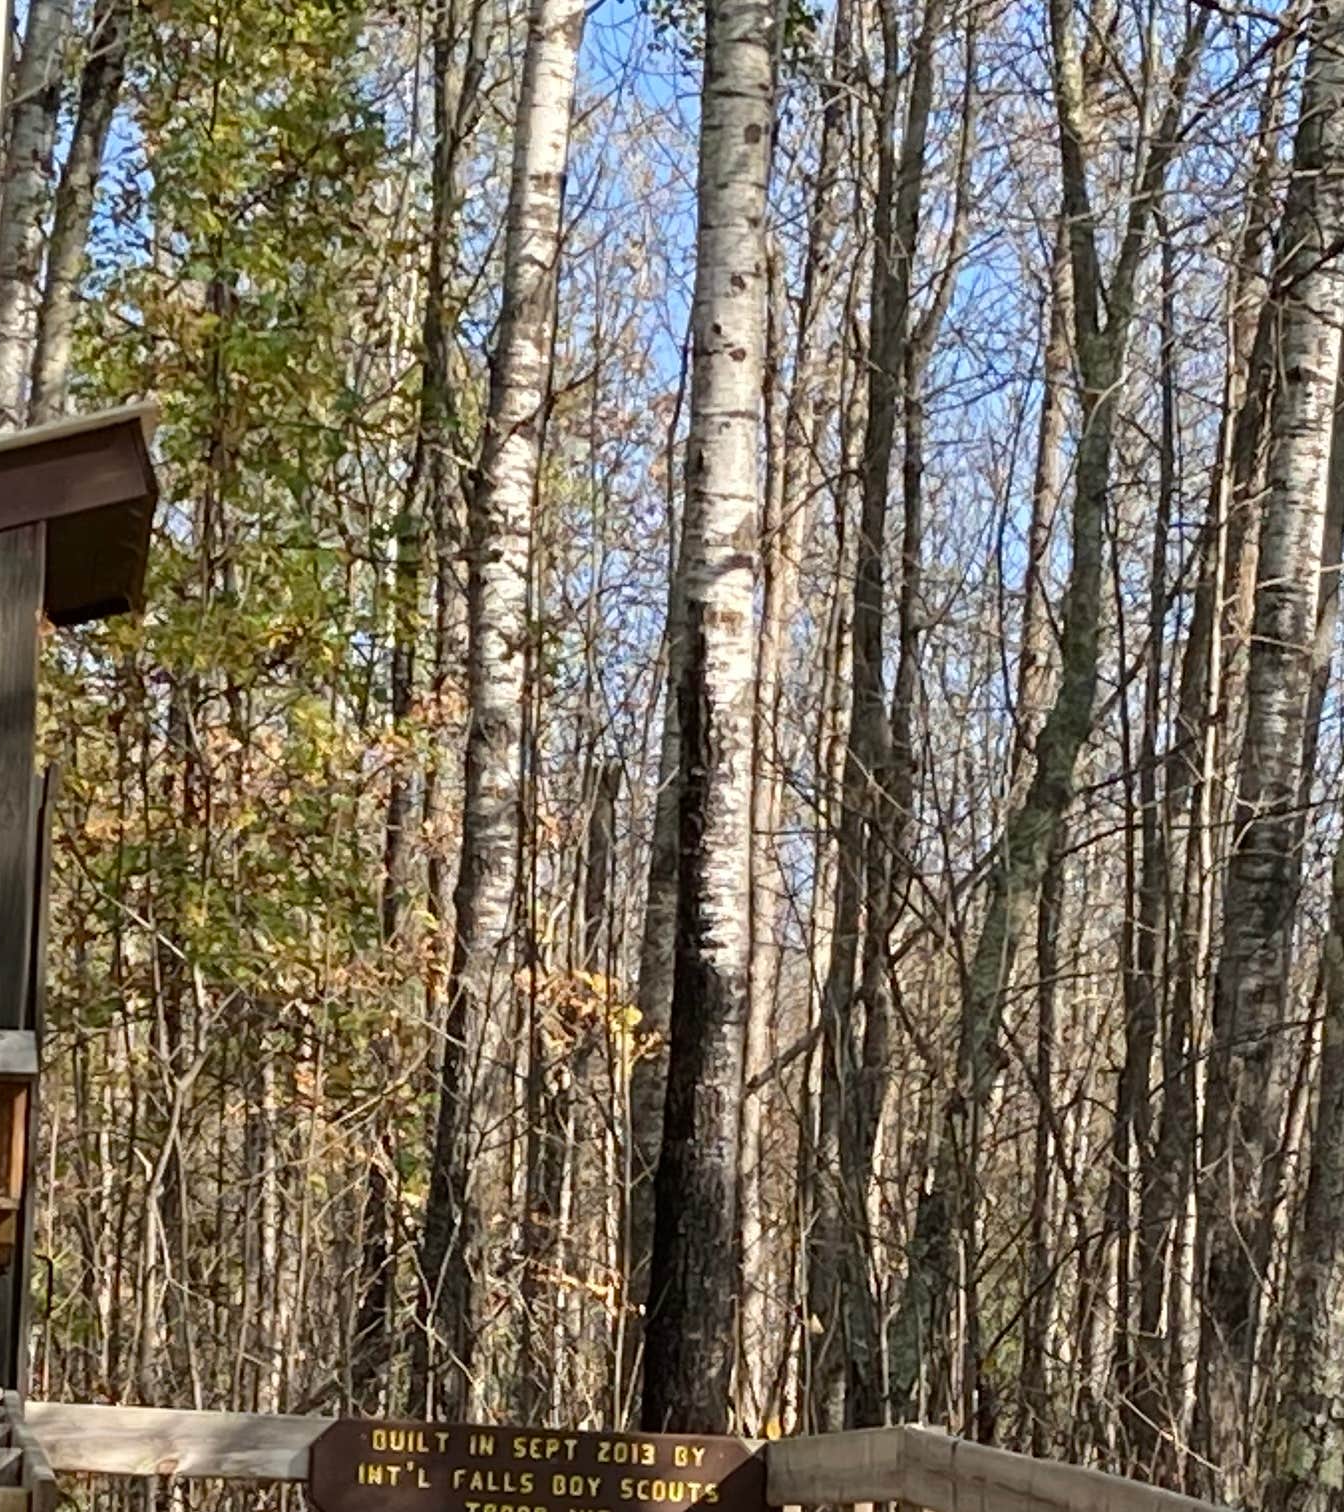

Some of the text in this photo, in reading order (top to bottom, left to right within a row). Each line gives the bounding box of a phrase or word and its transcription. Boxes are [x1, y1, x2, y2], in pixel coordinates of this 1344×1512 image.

[372, 1429, 706, 1467] BUILT IN SEPT 2013 BY
[358, 1461, 719, 1503] INT'L FALLS BOY SCOUTS
